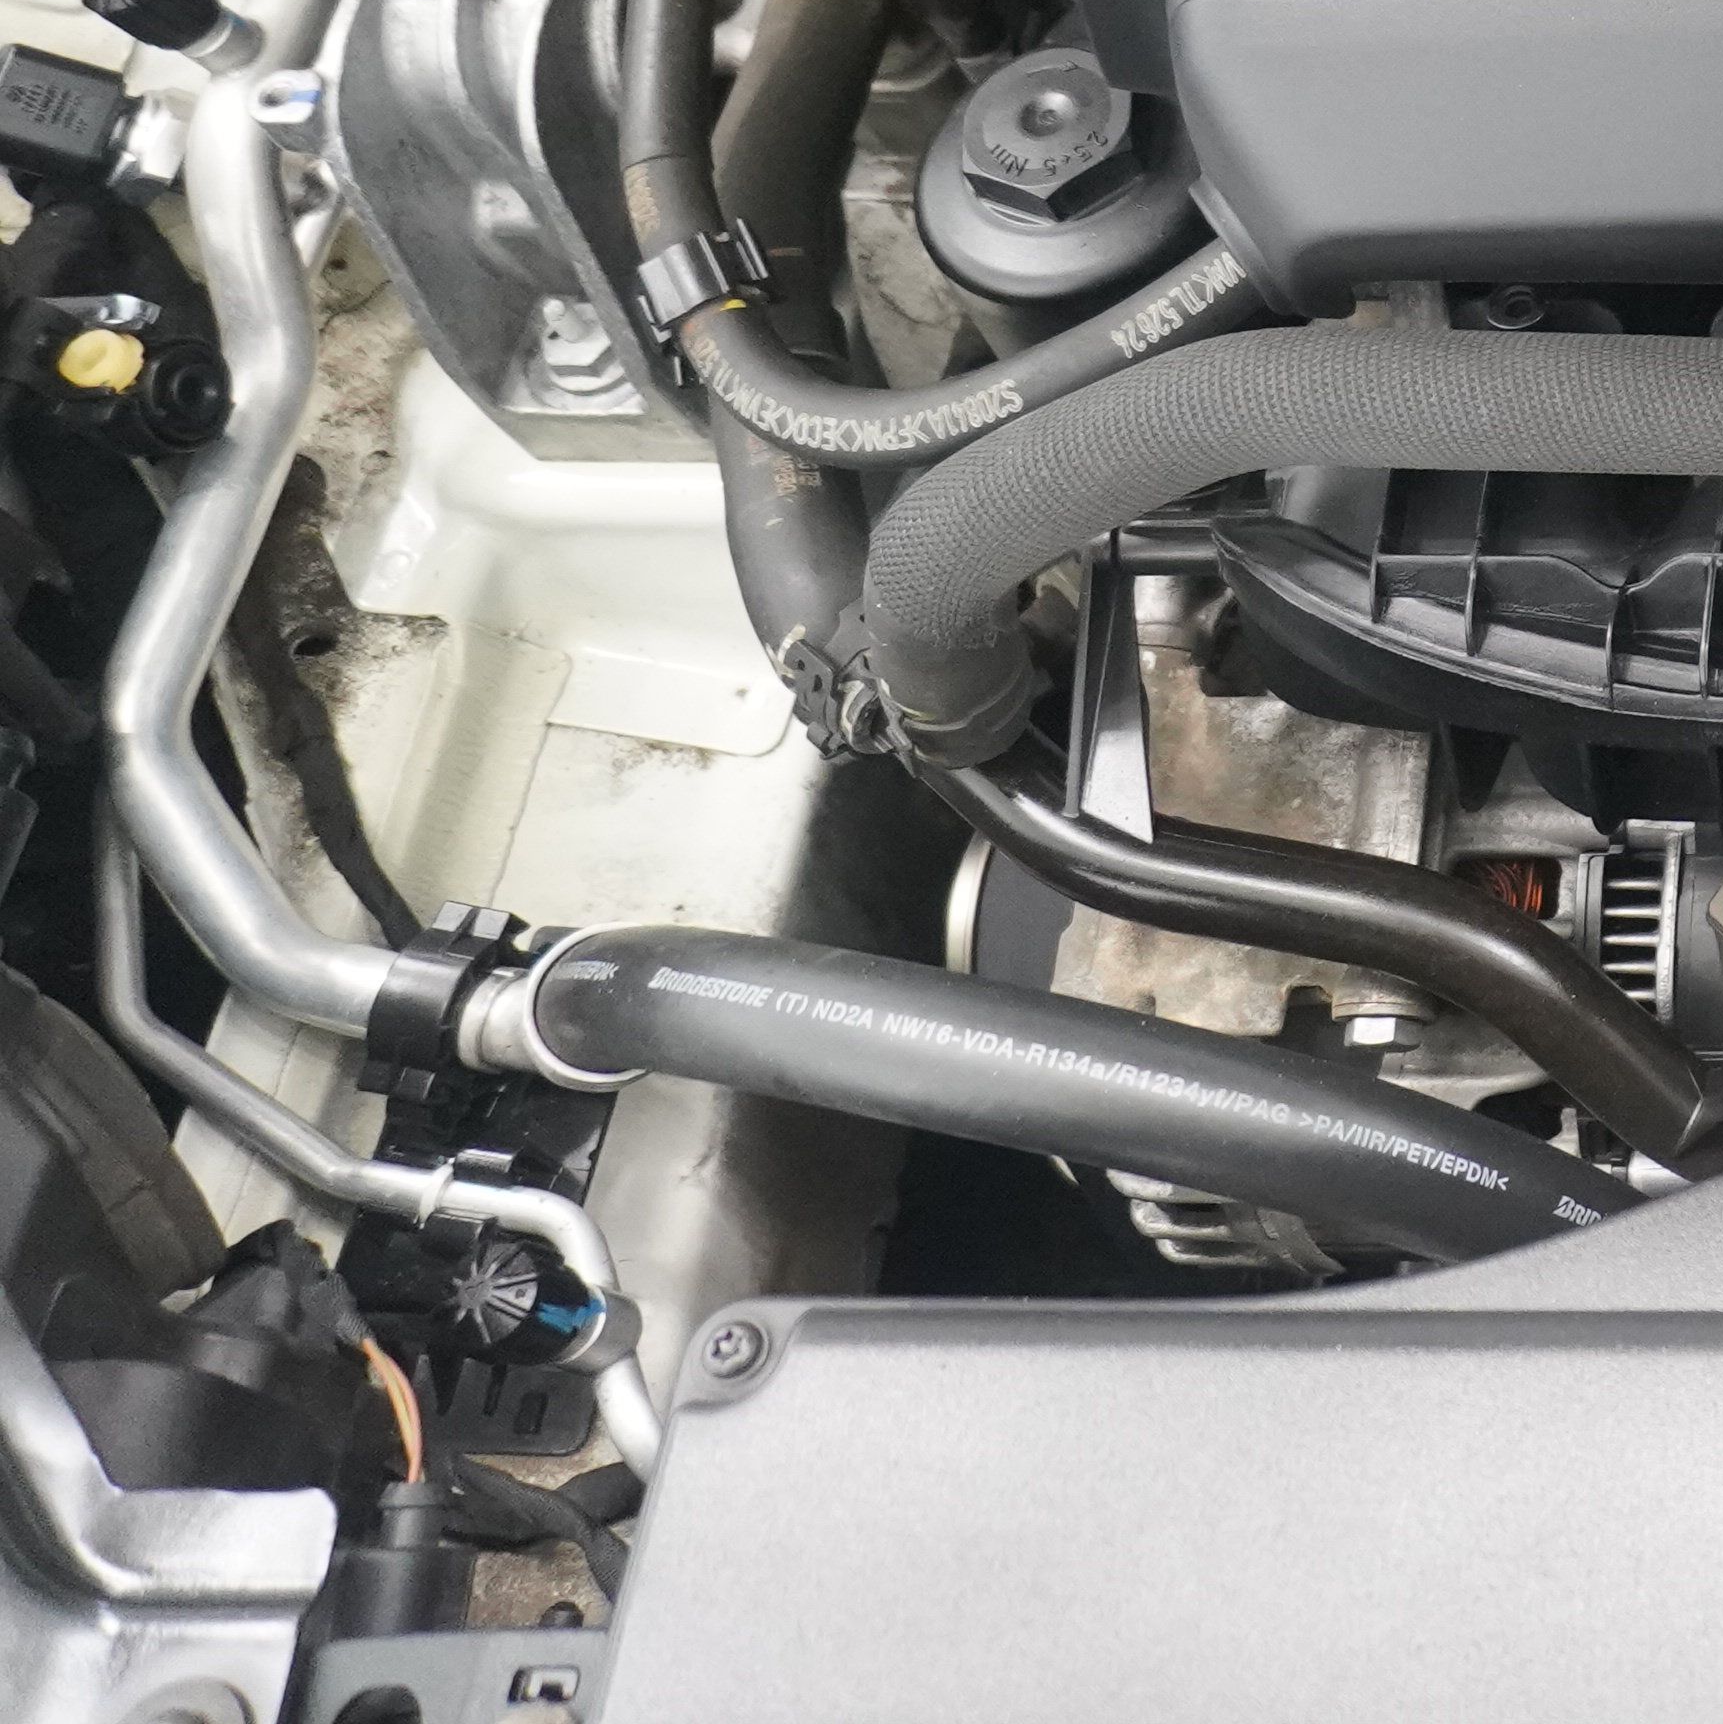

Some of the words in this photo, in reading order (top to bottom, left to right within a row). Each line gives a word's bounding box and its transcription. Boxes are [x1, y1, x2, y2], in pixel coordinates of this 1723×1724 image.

[648, 966, 773, 1009] BRIDGESTONE
[775, 990, 808, 1016] (T)
[812, 997, 873, 1030] ND2A
